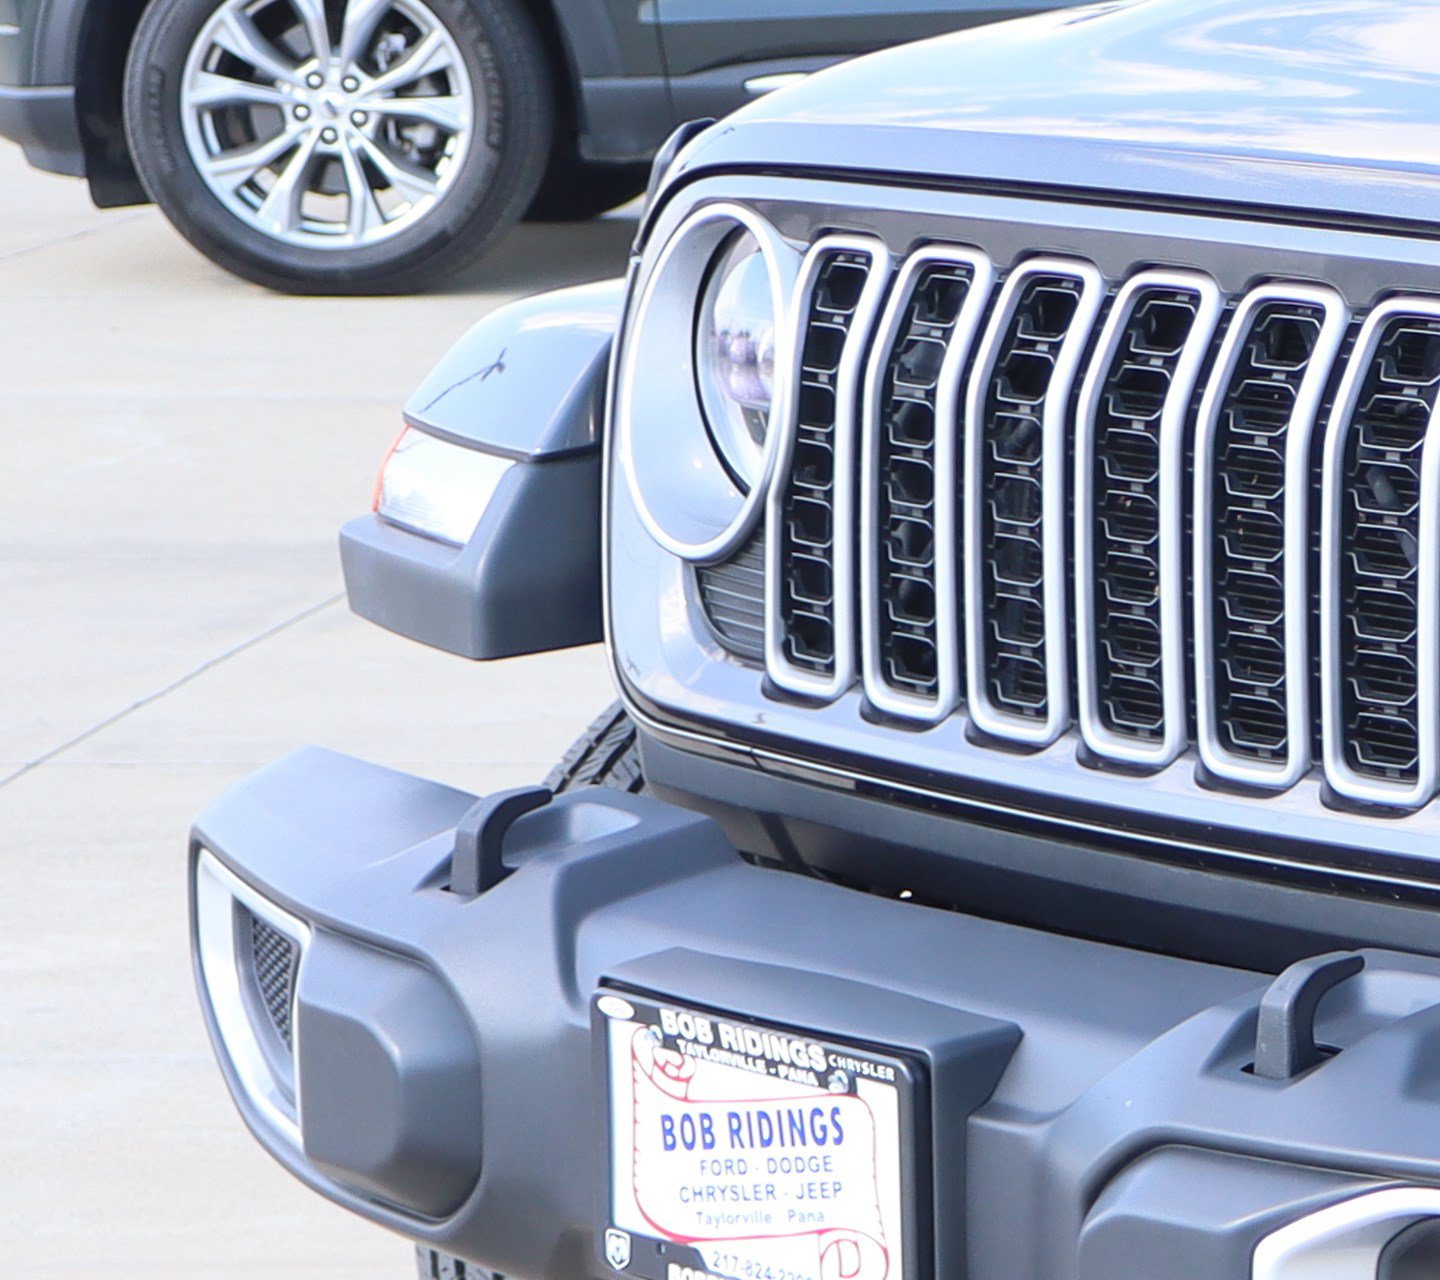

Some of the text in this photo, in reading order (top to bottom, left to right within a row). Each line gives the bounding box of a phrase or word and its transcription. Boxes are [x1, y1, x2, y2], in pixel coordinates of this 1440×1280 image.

[659, 1007, 896, 1082] BOB RIDINGS CHRYSLER
[660, 1106, 845, 1152] BOB RIDINGS
[699, 1155, 834, 1177] FORD DODGE
[679, 1181, 843, 1204] CHRYSLER JEEP
[695, 1208, 826, 1230] Taylorville Pana
